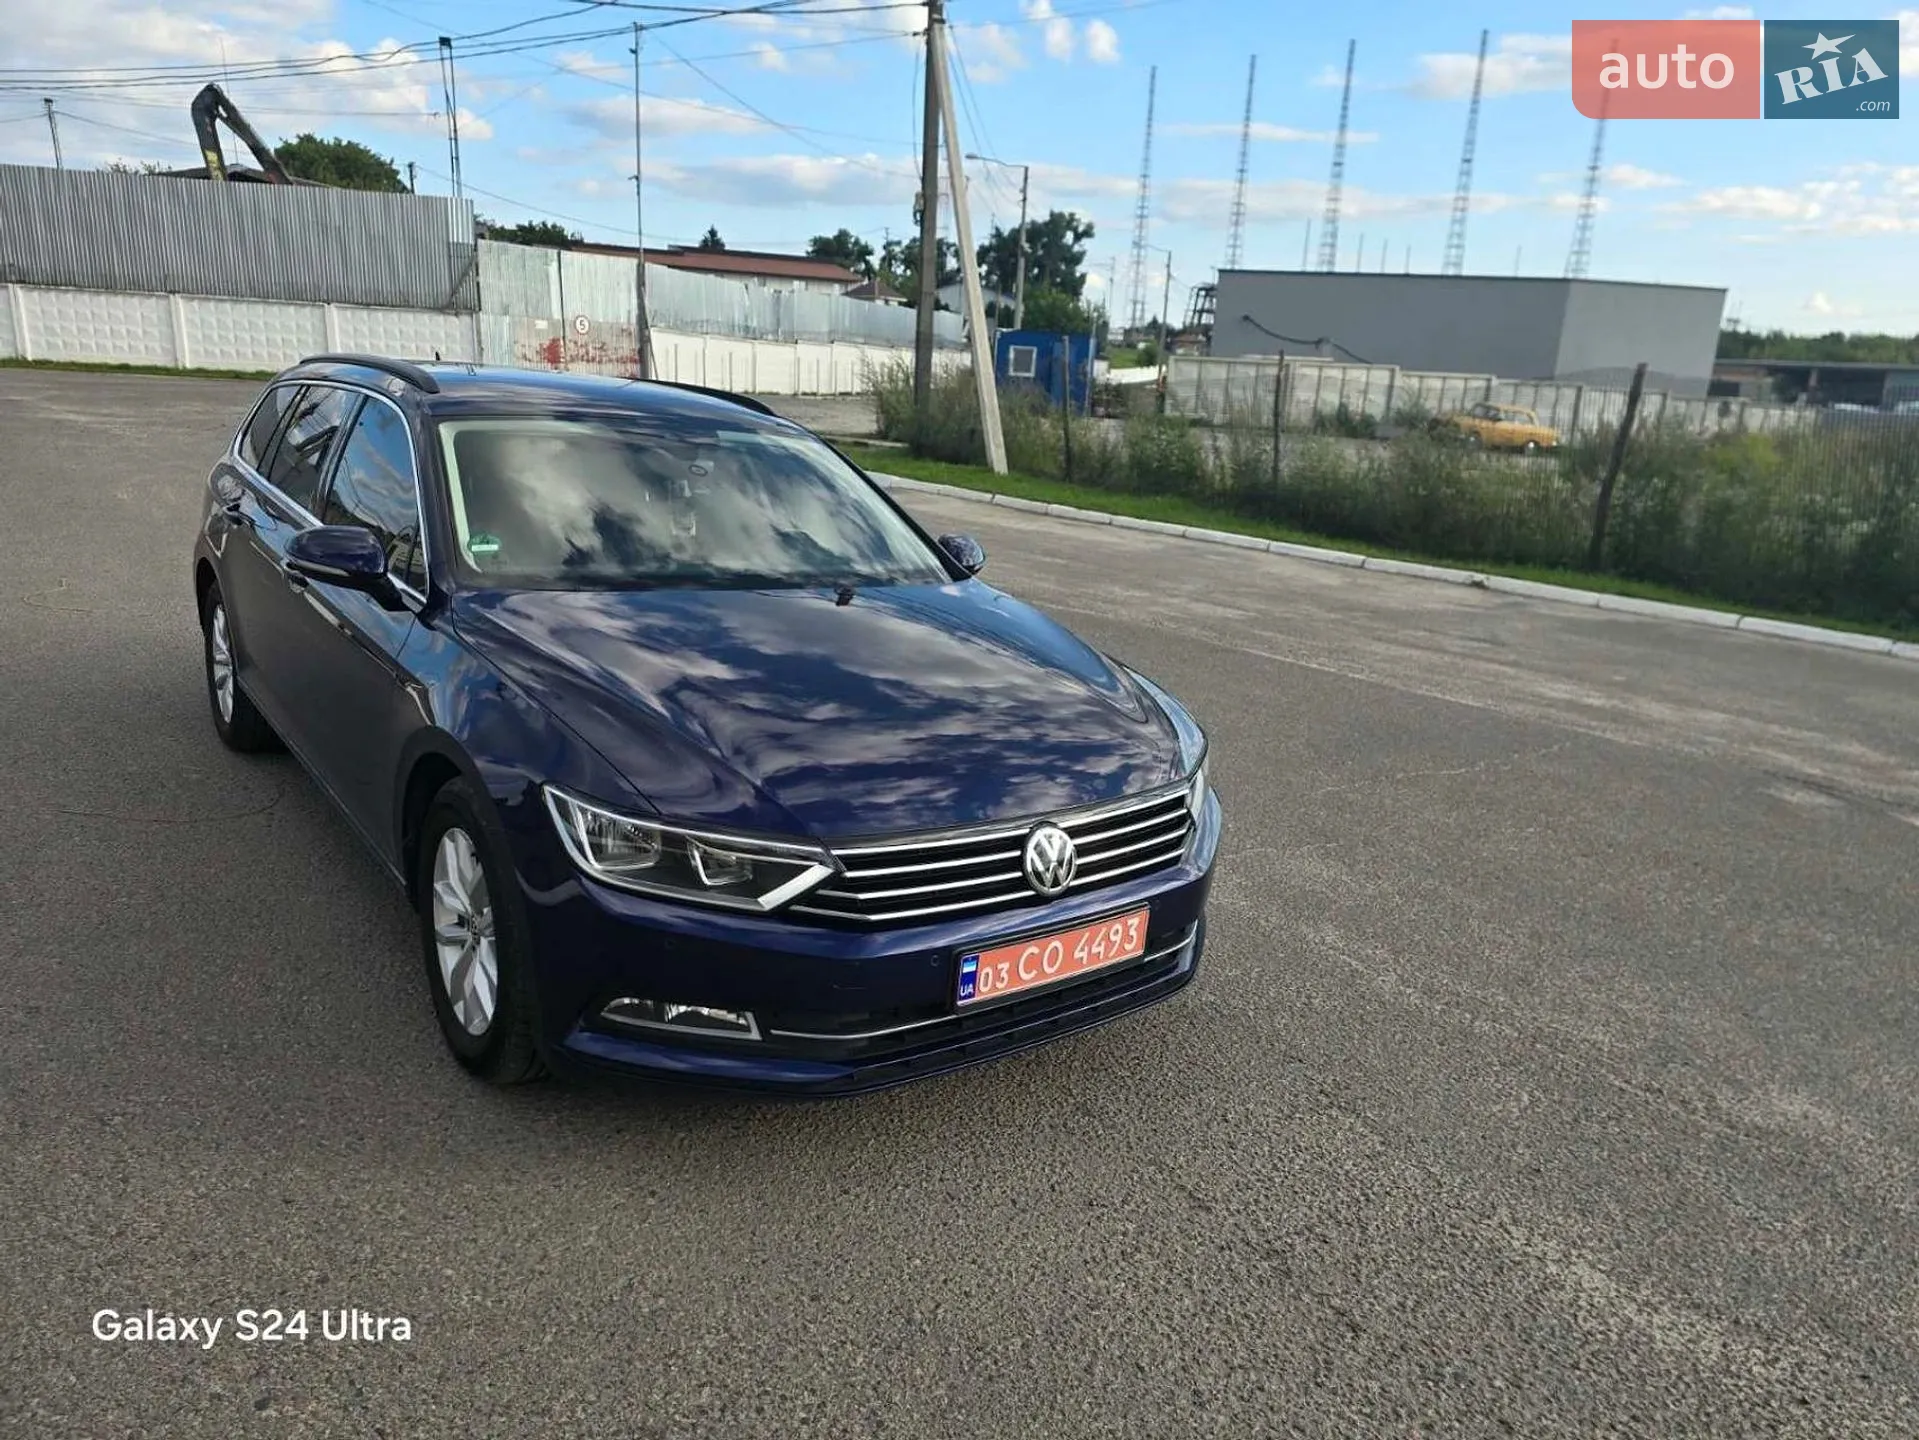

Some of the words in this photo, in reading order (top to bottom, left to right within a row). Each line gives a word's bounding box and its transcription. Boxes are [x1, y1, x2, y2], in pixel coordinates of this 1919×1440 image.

[1027, 827, 1075, 892] VW
[978, 962, 1010, 992] 03
[1017, 940, 1064, 981] CO
[1073, 917, 1140, 965] 4493
[959, 983, 975, 996] UA
